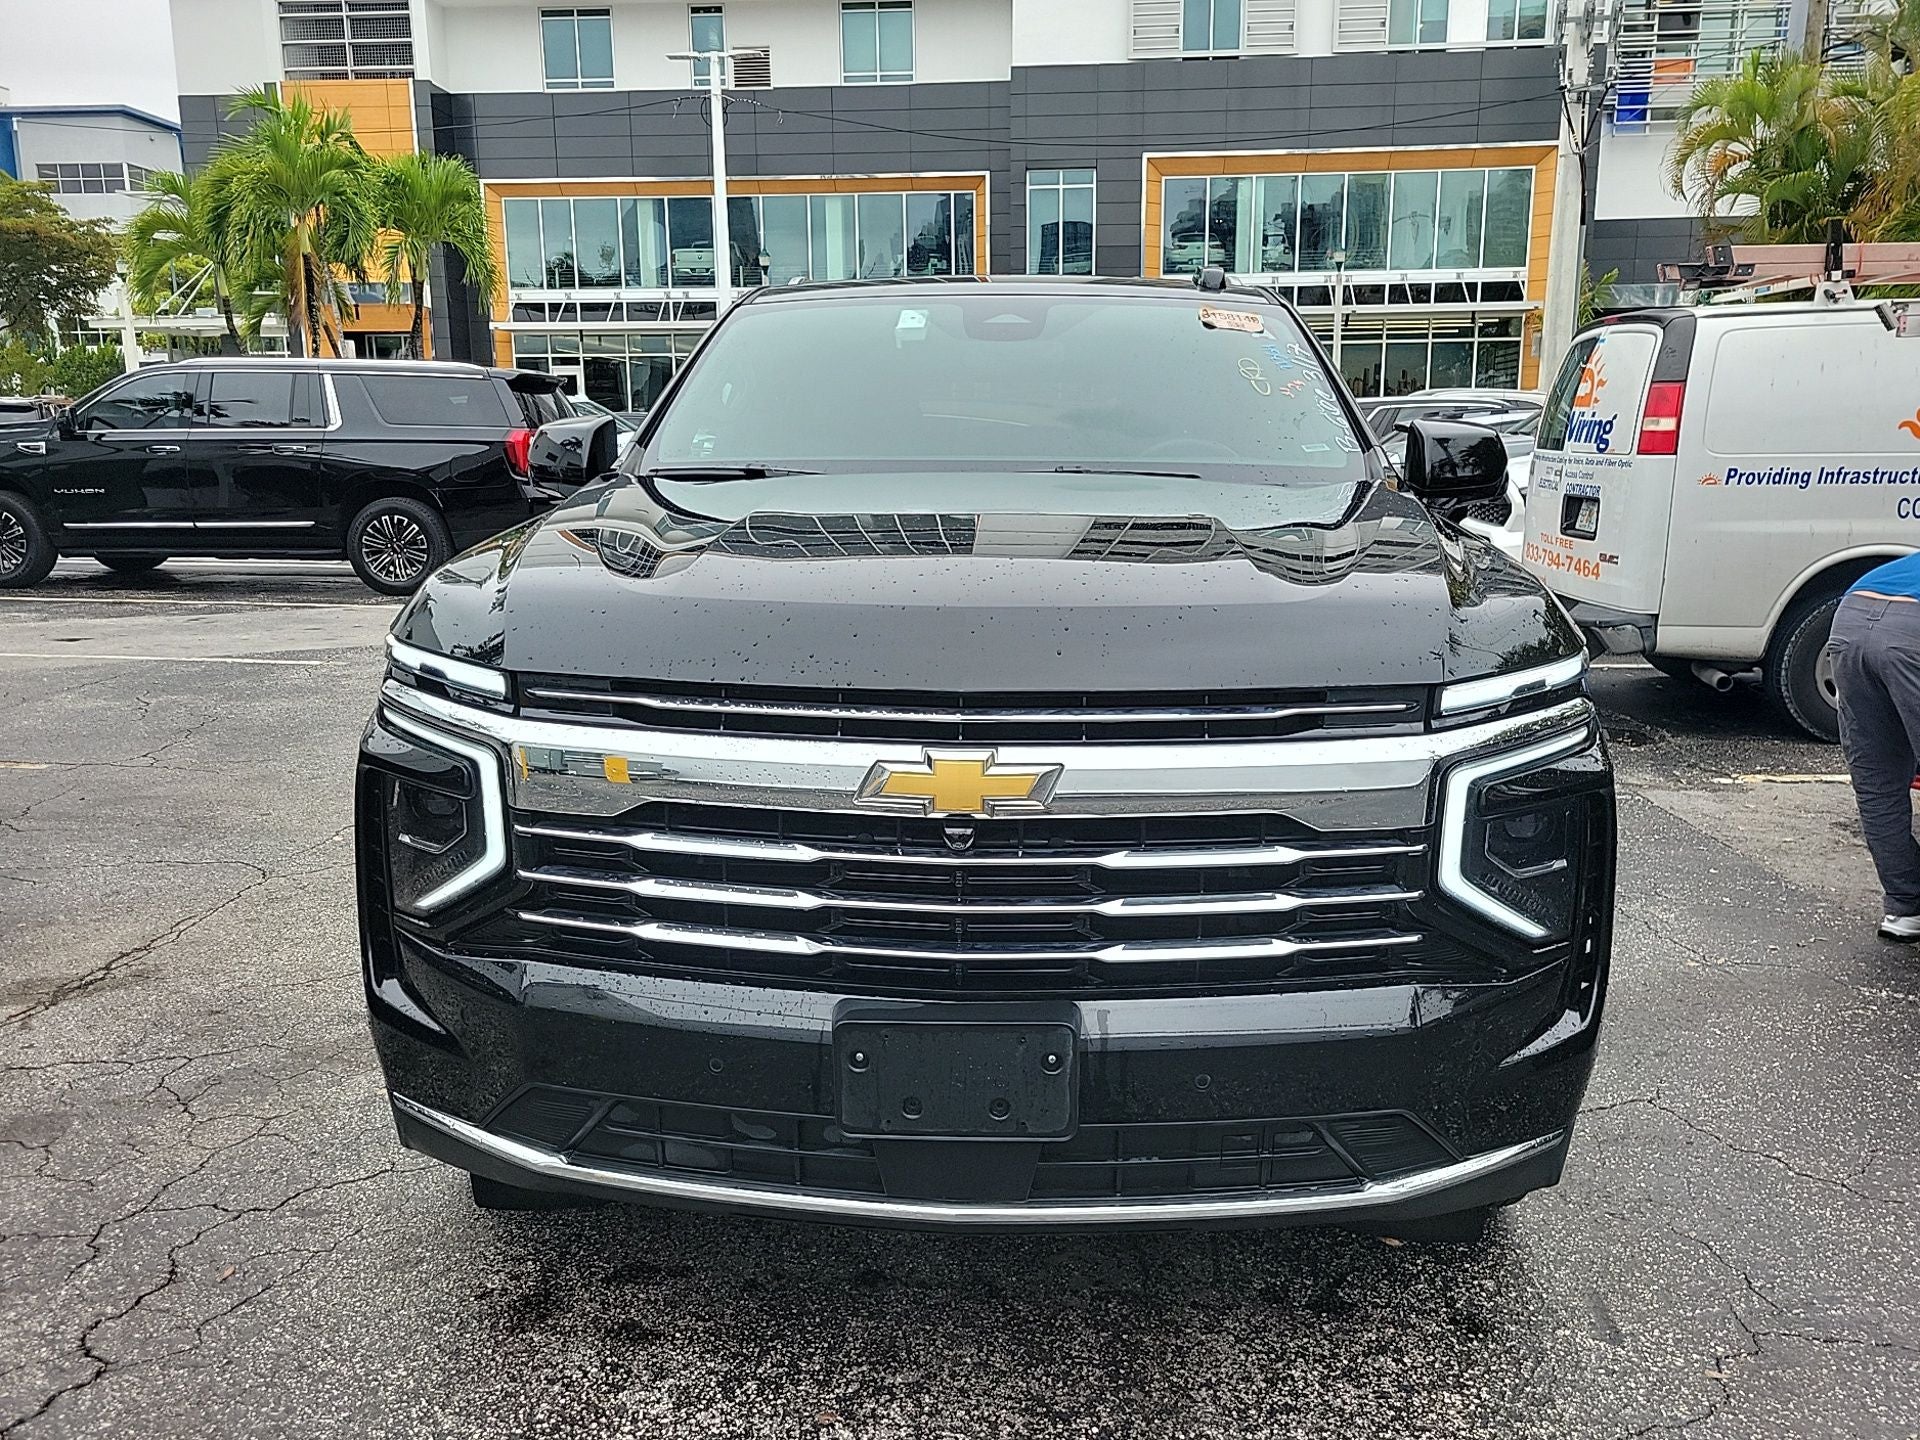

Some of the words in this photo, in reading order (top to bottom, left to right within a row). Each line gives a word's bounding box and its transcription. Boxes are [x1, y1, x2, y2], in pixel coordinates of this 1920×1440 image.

[1604, 459, 1617, 467] Fiber
[1617, 460, 1633, 468] Optic
[1578, 469, 1595, 480] Control
[1725, 467, 1812, 489] Providing
[1817, 466, 1920, 484] Infrastruct
[1565, 482, 1601, 497] CONTRACTOR
[1540, 533, 1554, 545] TOLL
[1555, 537, 1574, 549] FREE
[1526, 543, 1600, 580] 833-794-7464
